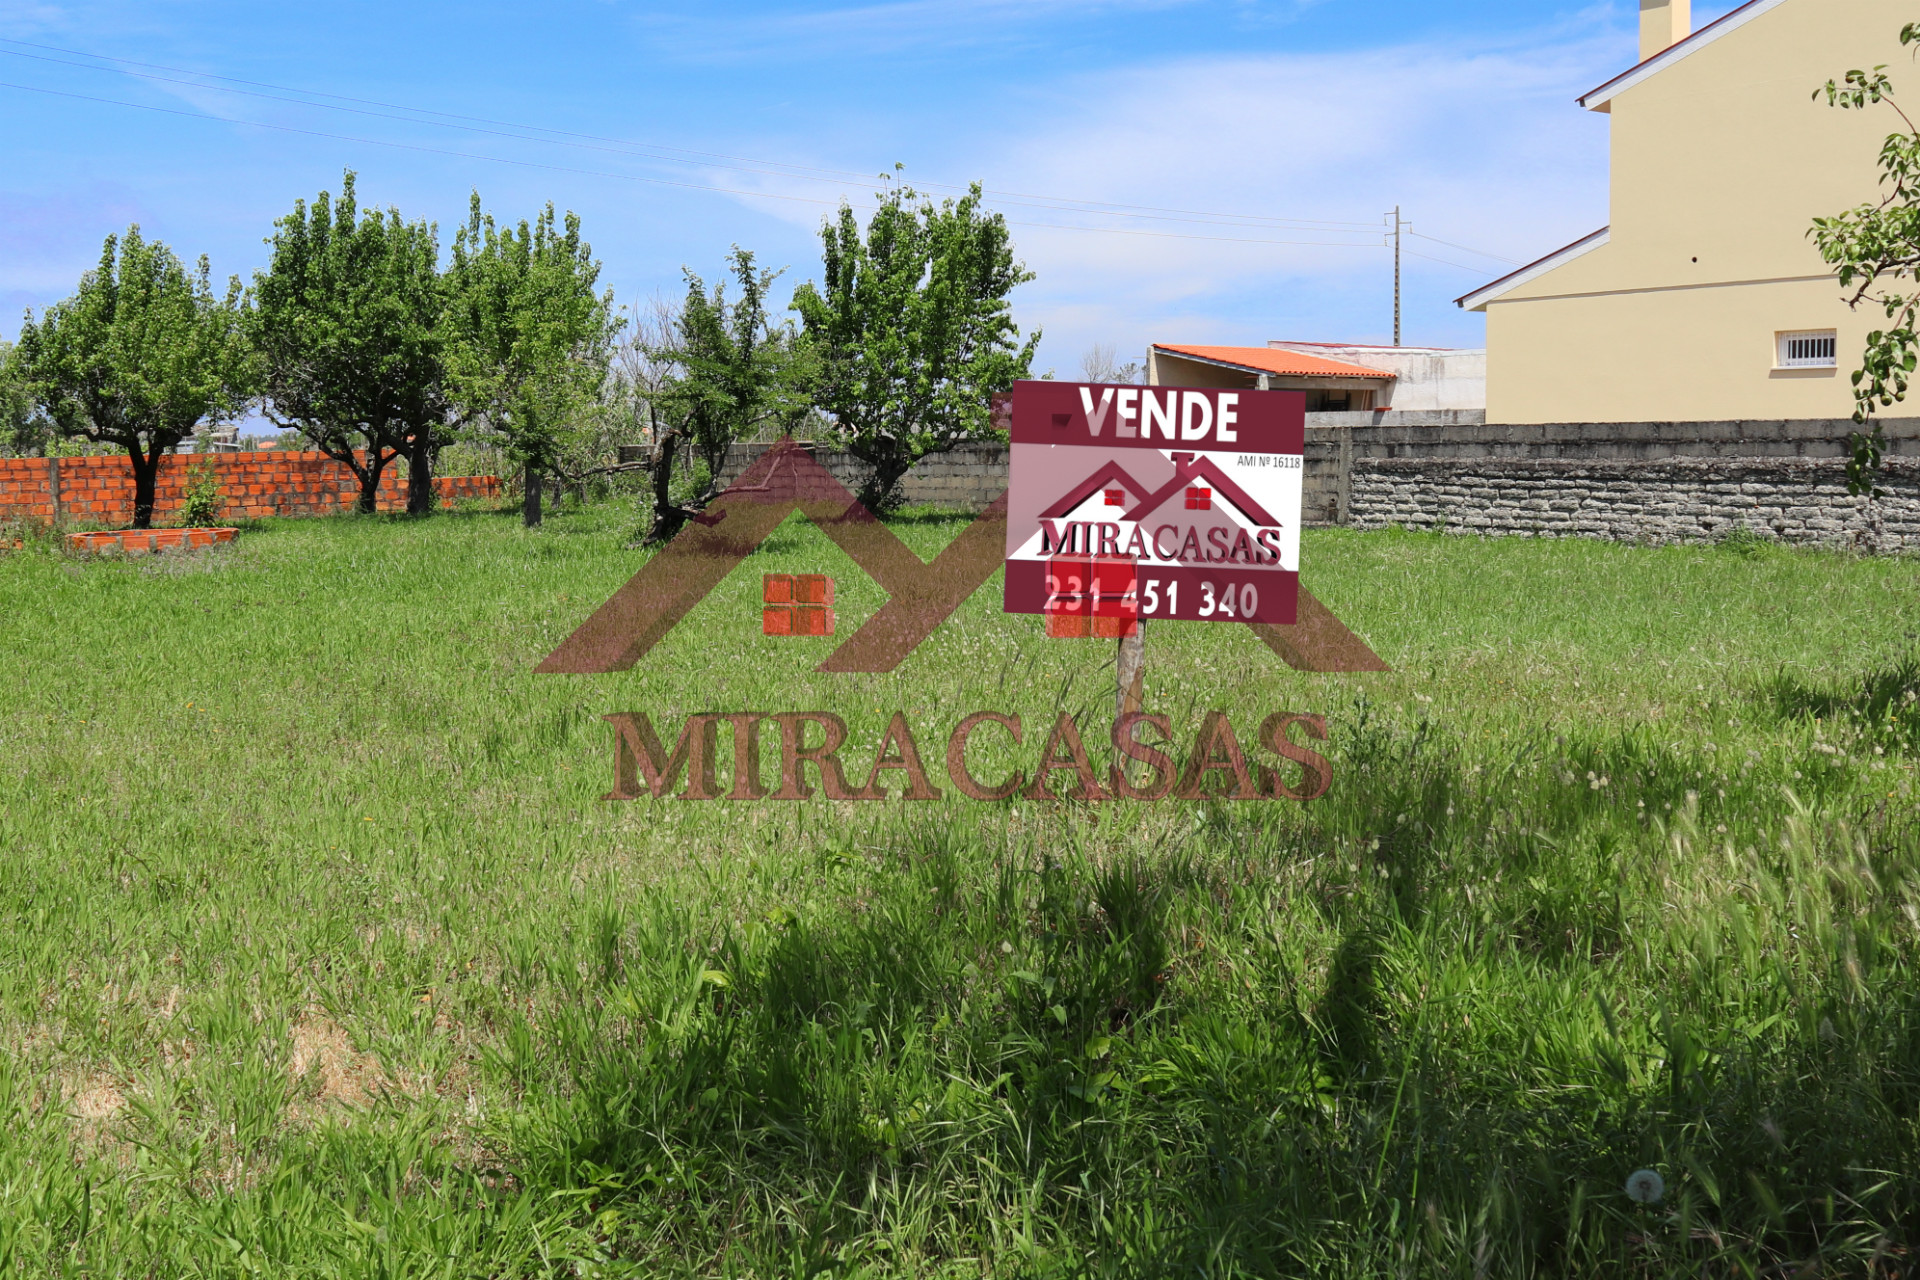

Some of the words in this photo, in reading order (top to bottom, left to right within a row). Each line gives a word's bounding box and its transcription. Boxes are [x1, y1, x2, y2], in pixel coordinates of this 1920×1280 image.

[1079, 386, 1239, 442] VENDE
[1237, 455, 1257, 467] AMI
[1273, 457, 1301, 469] 16118
[1036, 520, 1282, 566] MIRACASAS
[1043, 575, 1100, 611] 231
[1121, 579, 1178, 615] 451
[1198, 581, 1259, 619] 340
